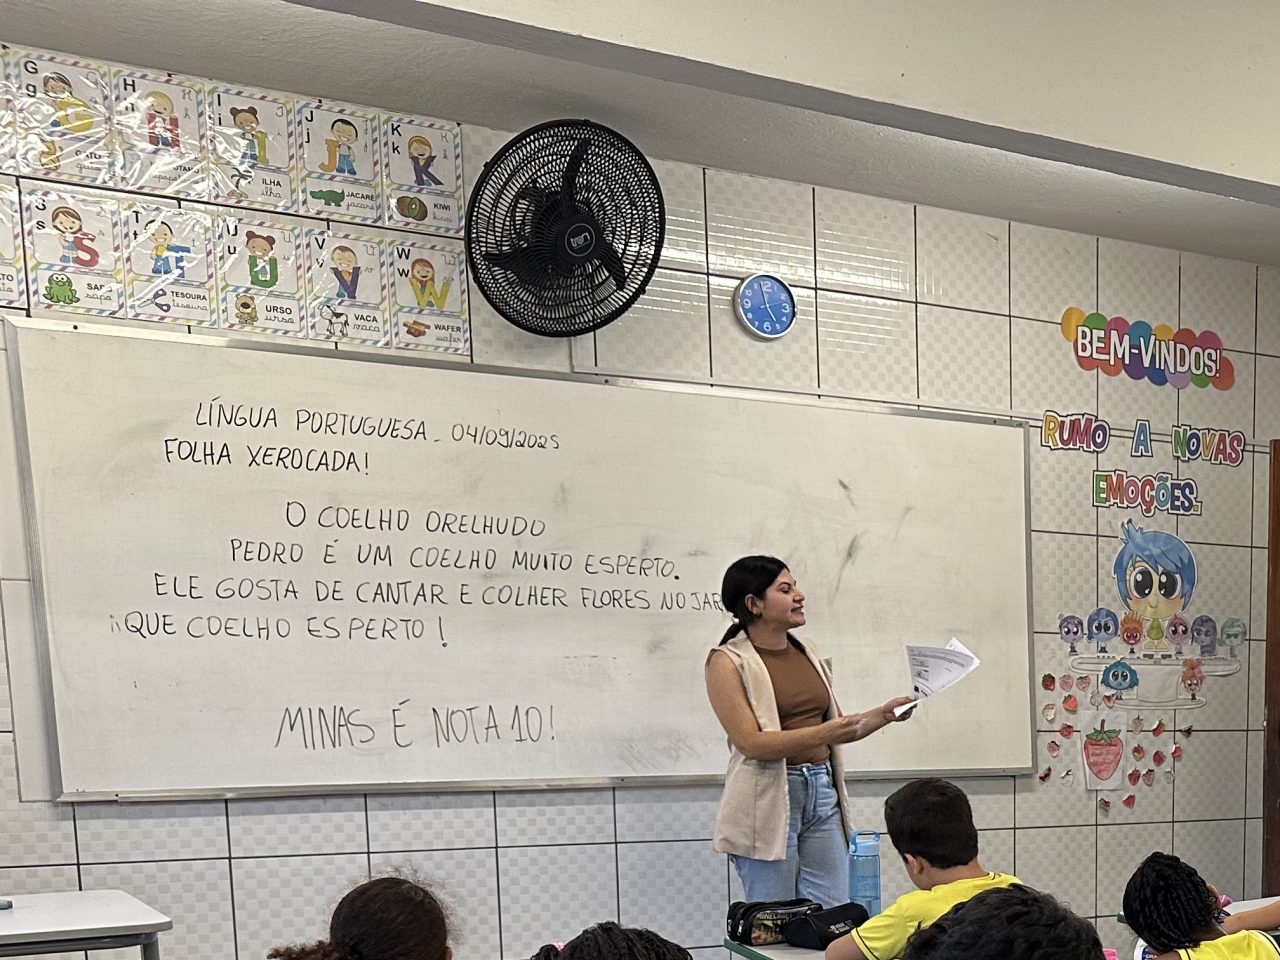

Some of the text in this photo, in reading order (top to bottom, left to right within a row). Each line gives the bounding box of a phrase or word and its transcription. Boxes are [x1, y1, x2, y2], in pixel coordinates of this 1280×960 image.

[24, 61, 38, 74] G
[124, 78, 135, 92] H
[392, 124, 402, 137] K
[262, 178, 282, 187] ILHA
[346, 192, 375, 201] JACARÉ
[433, 203, 451, 211] KIWI
[170, 290, 207, 301] TESOURA
[265, 305, 293, 315] URSO
[354, 313, 378, 323] VACA
[434, 324, 462, 333] WAFER
[1077, 325, 1221, 378] BEM-VINDOS!
[196, 396, 277, 427] LÍNGUA
[296, 409, 427, 441] PORTUGUESA
[452, 424, 559, 449] 04/09/2025
[1043, 411, 1244, 465] RUMO A NOVAS
[164, 438, 369, 475] FOLHA XEROCADA!
[1093, 470, 1202, 516] EMOÇÕES.
[286, 501, 546, 536] O COELHO ORELHUDO
[231, 539, 680, 580] PEDRO É UM COELHO MUITO ESPERTO.
[154, 572, 723, 612] ELE GOSTA DE CANTAR E COLHER FLORES NO JAR
[124, 611, 177, 639] QUE
[187, 616, 291, 640] COELHO
[275, 705, 376, 750] MINAS
[392, 699, 413, 748] É
[432, 704, 501, 748] NOTA
